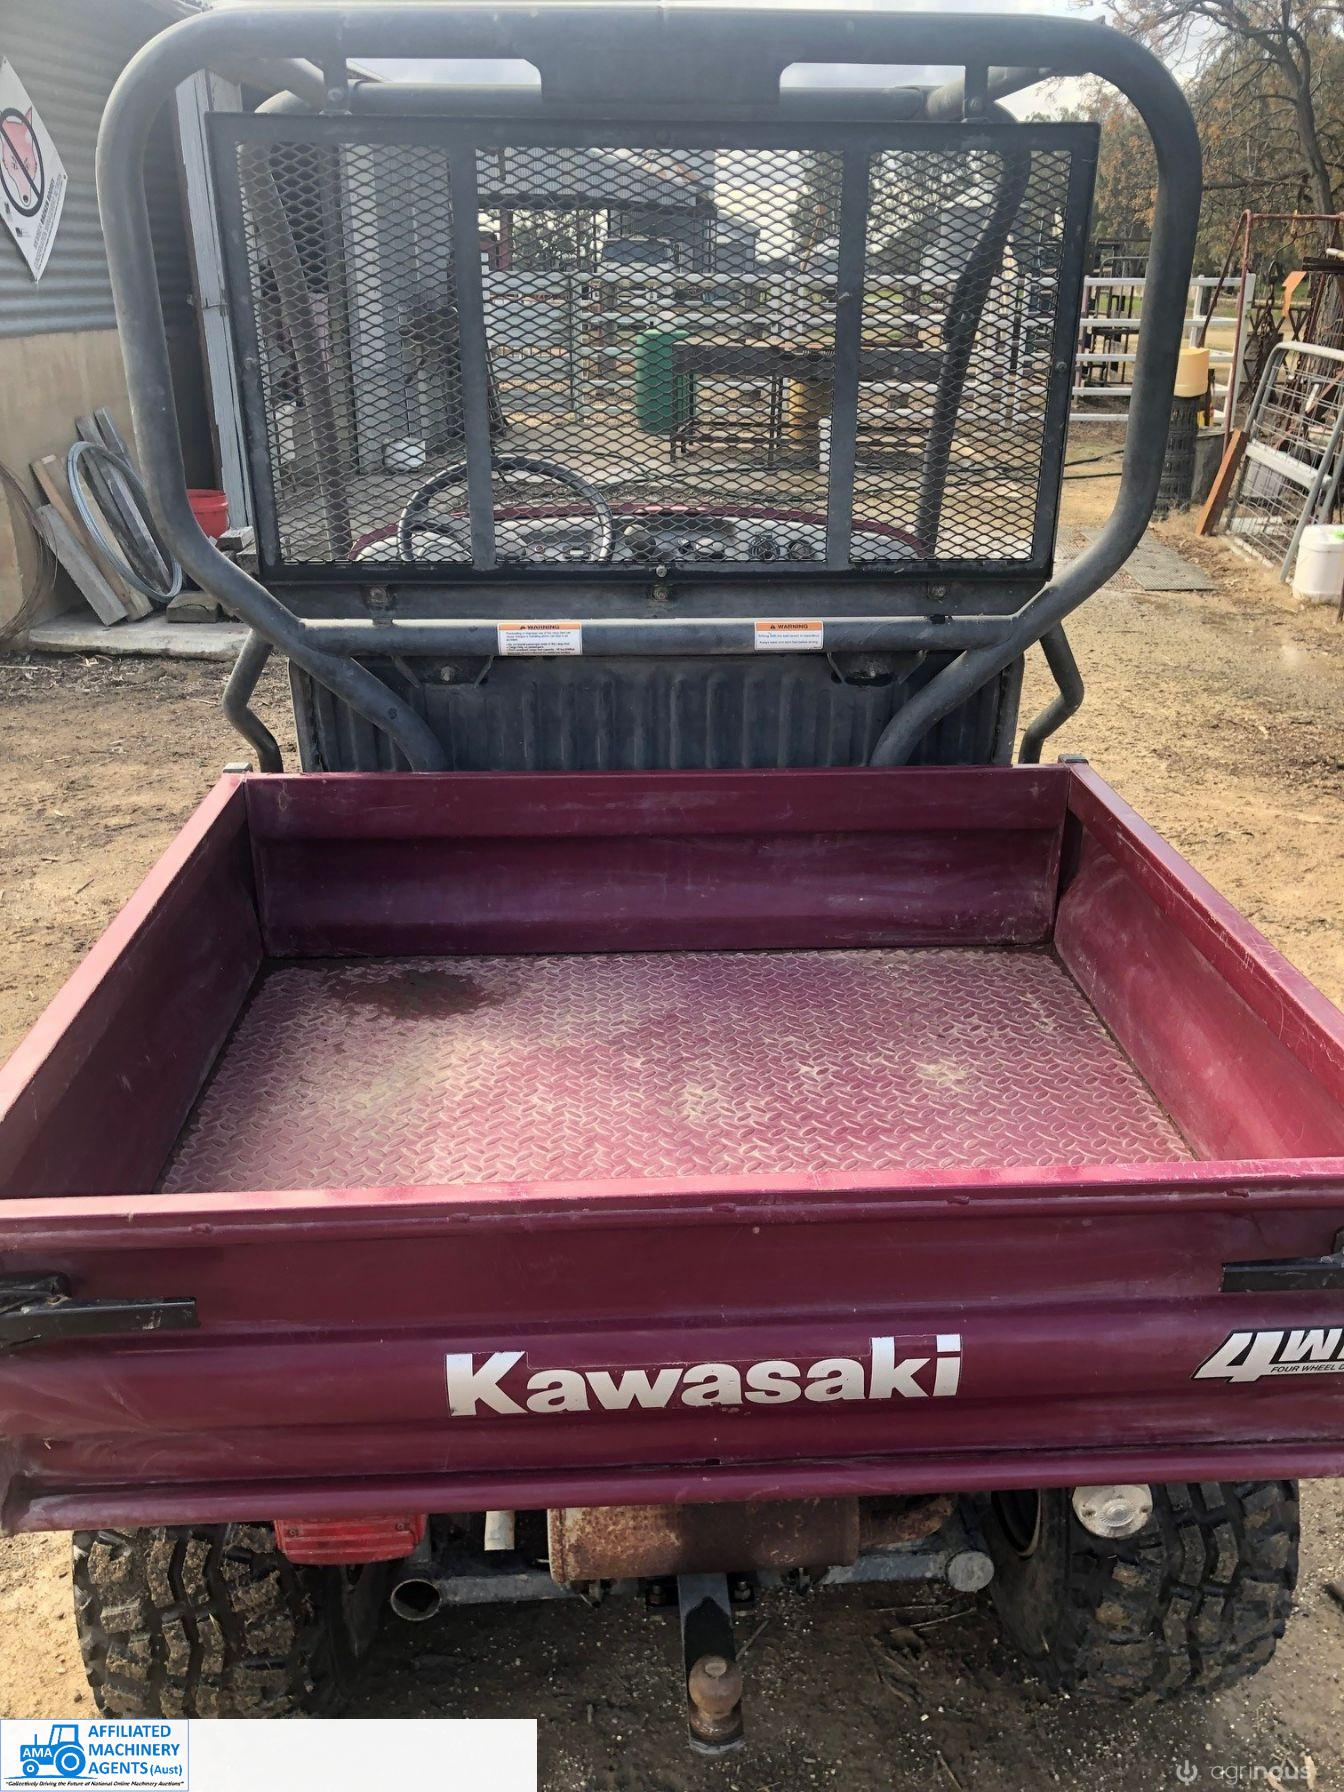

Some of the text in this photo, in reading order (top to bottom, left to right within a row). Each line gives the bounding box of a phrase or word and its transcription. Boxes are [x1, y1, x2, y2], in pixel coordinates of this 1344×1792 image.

[446, 1334, 961, 1417] Kawasaki
[1193, 1328, 1344, 1382] 4W
[1270, 1365, 1300, 1373] FOUR
[1301, 1364, 1336, 1372] WHEEL
